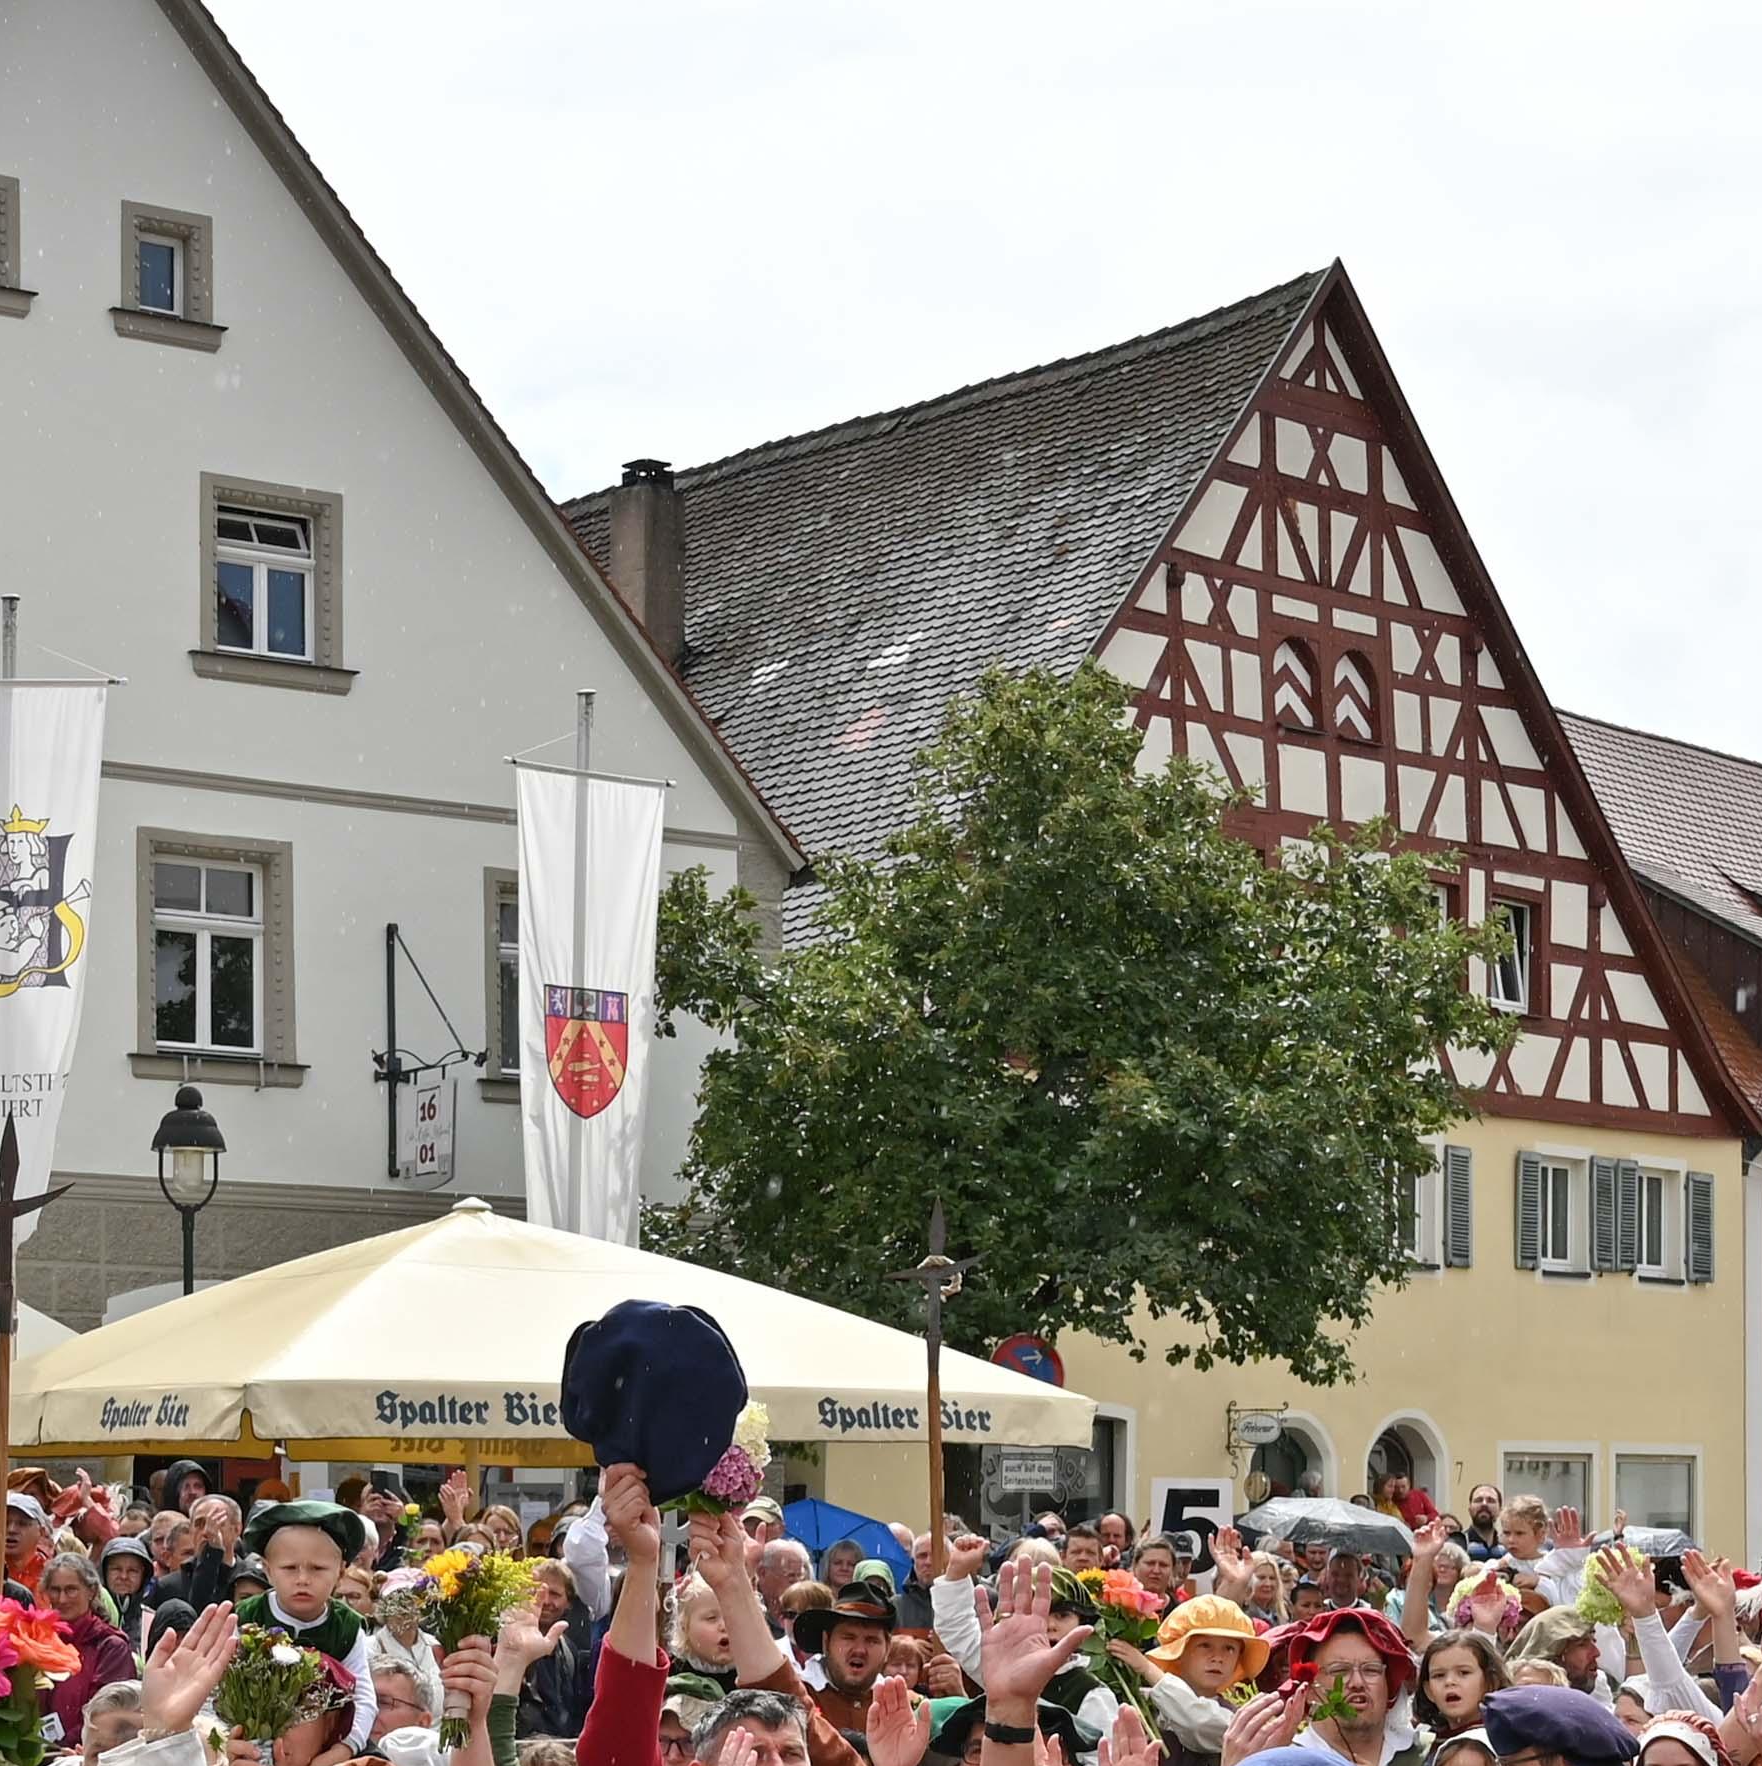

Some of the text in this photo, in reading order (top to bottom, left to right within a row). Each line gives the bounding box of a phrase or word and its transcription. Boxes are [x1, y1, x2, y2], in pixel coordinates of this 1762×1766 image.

[420, 1094, 437, 1122] 16
[419, 1142, 436, 1164] 01
[100, 1394, 190, 1432] Spalter Bier
[375, 1389, 565, 1431] Spalter Bie
[818, 1396, 919, 1434] Spalter
[1161, 1488, 1220, 1575] 5
